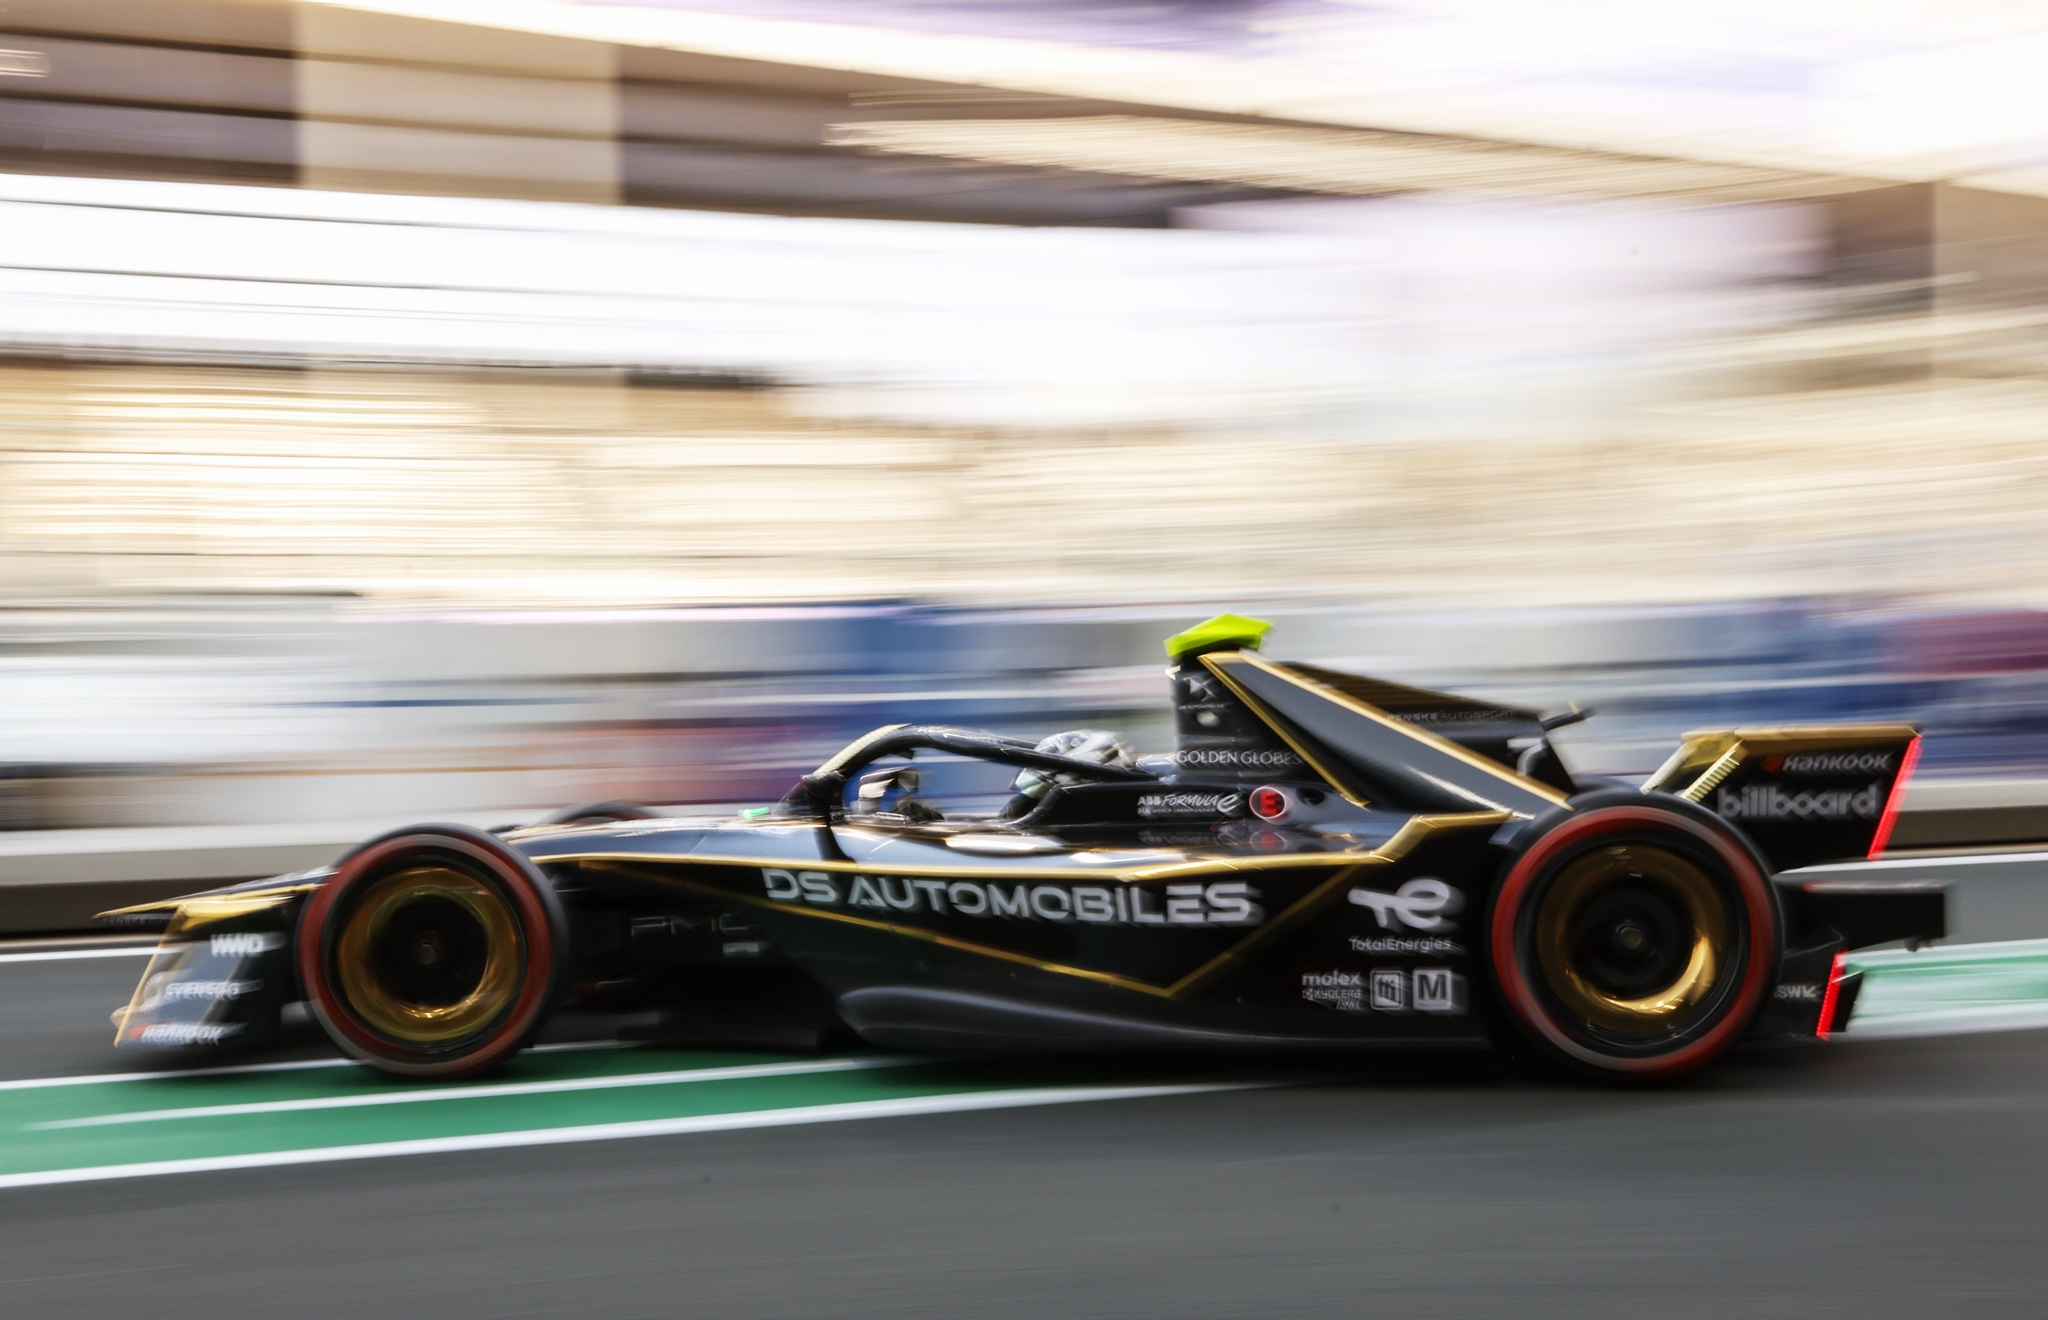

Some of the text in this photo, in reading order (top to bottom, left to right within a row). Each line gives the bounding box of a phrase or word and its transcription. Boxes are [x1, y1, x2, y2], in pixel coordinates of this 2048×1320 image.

[1387, 712, 1437, 721] PENSKE
[1176, 750, 1302, 765] GOLDEN GLOBES
[1137, 796, 1161, 806] ABB
[1161, 793, 1217, 809] FORMULA
[1717, 784, 1877, 818] billboard
[761, 867, 1252, 925] DS AUTOMOBILES
[210, 933, 264, 957] WWD
[1349, 935, 1452, 953] TotalEnergies
[1301, 970, 1362, 986] molex
[1313, 988, 1362, 999] KYOCERA
[1417, 974, 1447, 1000] M
